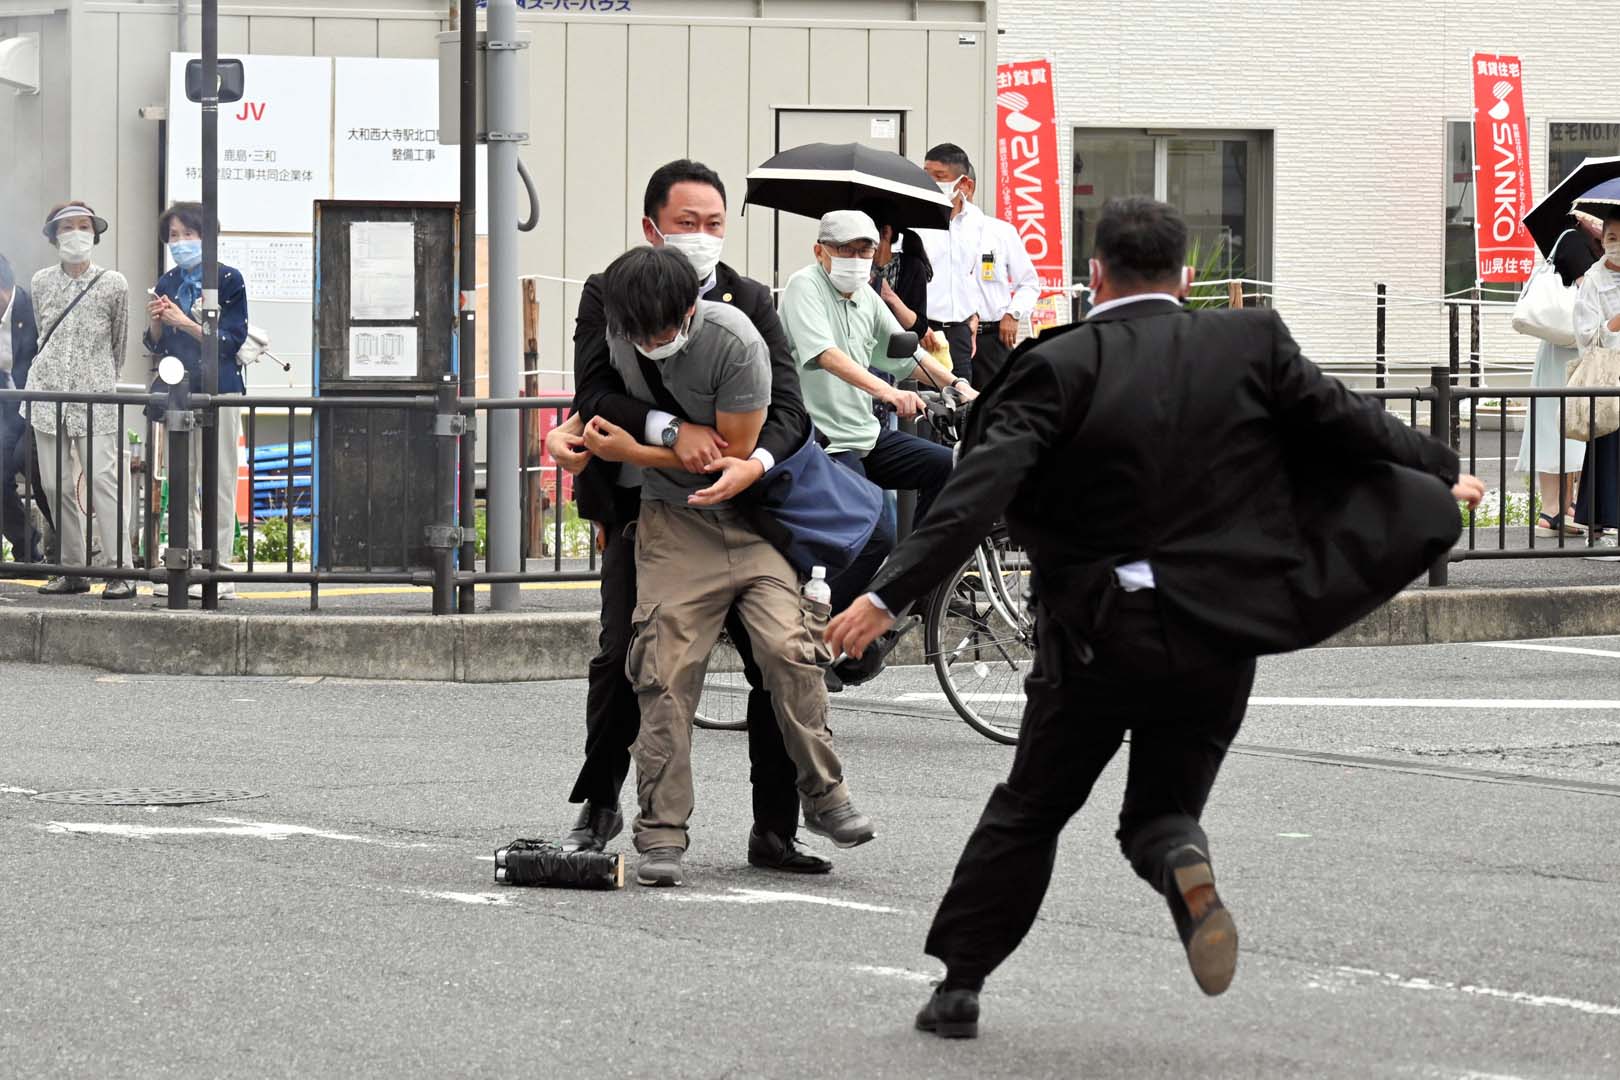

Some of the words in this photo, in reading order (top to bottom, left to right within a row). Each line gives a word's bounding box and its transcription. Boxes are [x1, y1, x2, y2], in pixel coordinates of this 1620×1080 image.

[1477, 60, 1520, 77] 賃貸住宅
[236, 102, 266, 121] JV
[348, 128, 439, 141] 大和西大寺駅北口
[392, 148, 436, 162] 整備工事
[185, 167, 313, 182] 特設工事共同企業体
[1492, 122, 1517, 242] SANKO
[1481, 257, 1533, 274] 山晃住宅
